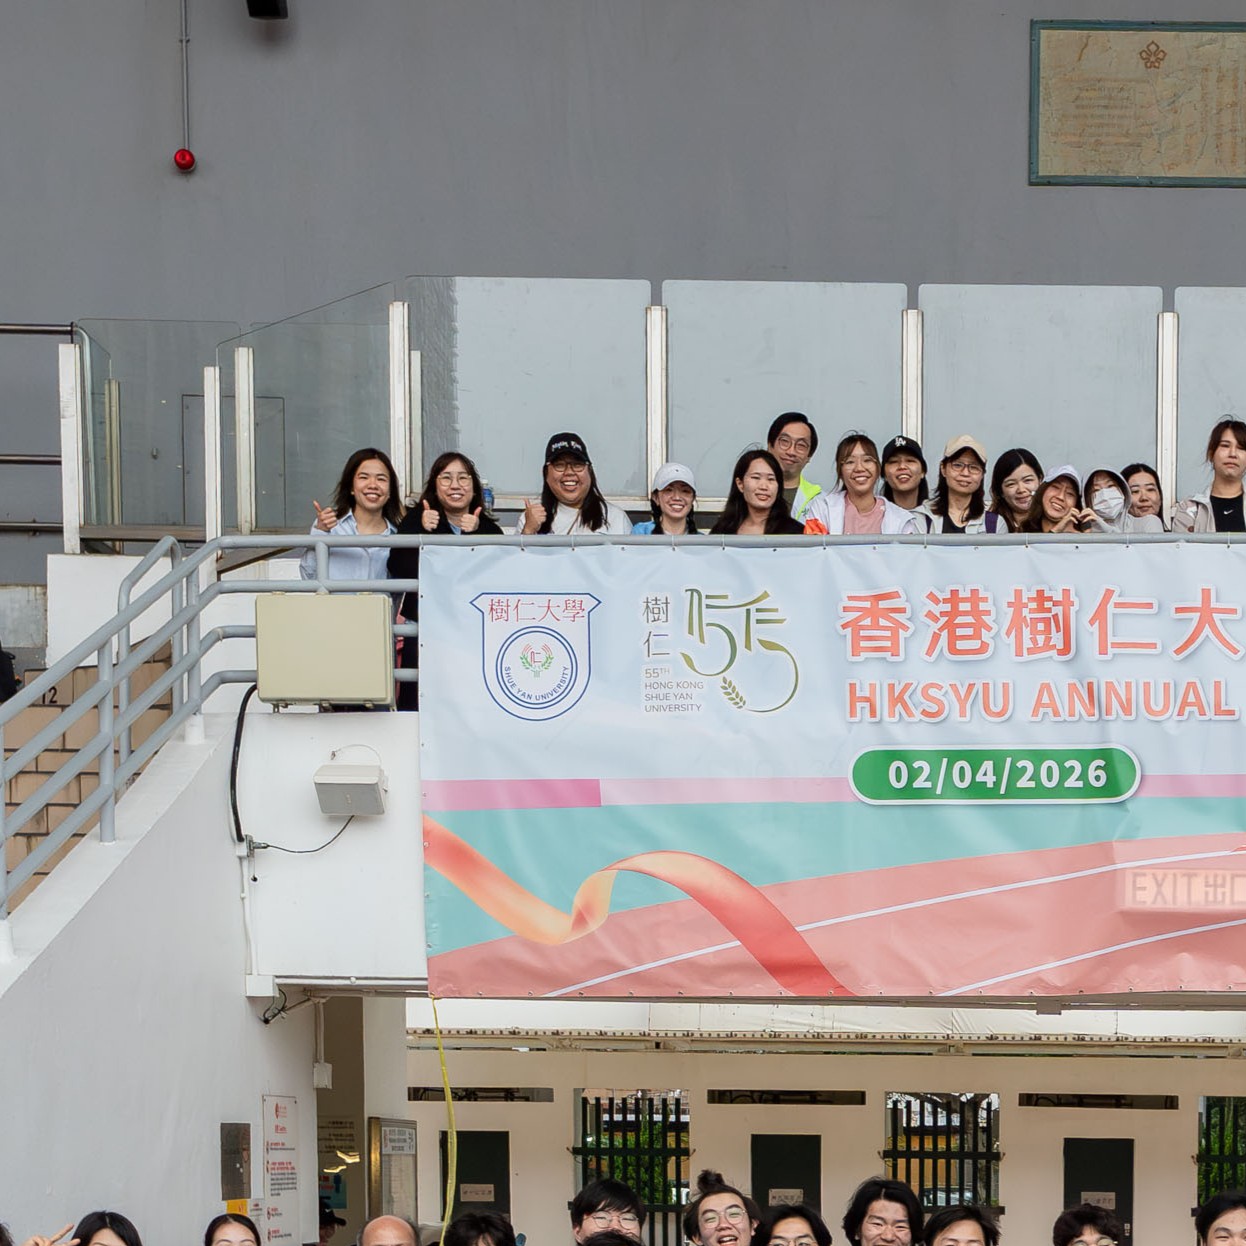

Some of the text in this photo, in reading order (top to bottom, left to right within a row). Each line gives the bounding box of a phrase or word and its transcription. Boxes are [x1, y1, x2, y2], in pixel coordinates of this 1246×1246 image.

[488, 598, 586, 623] 樹仁大學
[643, 596, 671, 658] 樹仁
[504, 665, 570, 701] SHUE YAN UNIVERSITY
[644, 680, 704, 690] HONG KONG
[644, 692, 693, 701] SHUE YAN
[848, 680, 1012, 720] HKSYU
[1031, 680, 1238, 719] ANNUAL
[644, 703, 703, 713] UNIVERSITY
[887, 757, 1108, 795] 02/04/2026
[1131, 872, 1199, 906] EXIT
